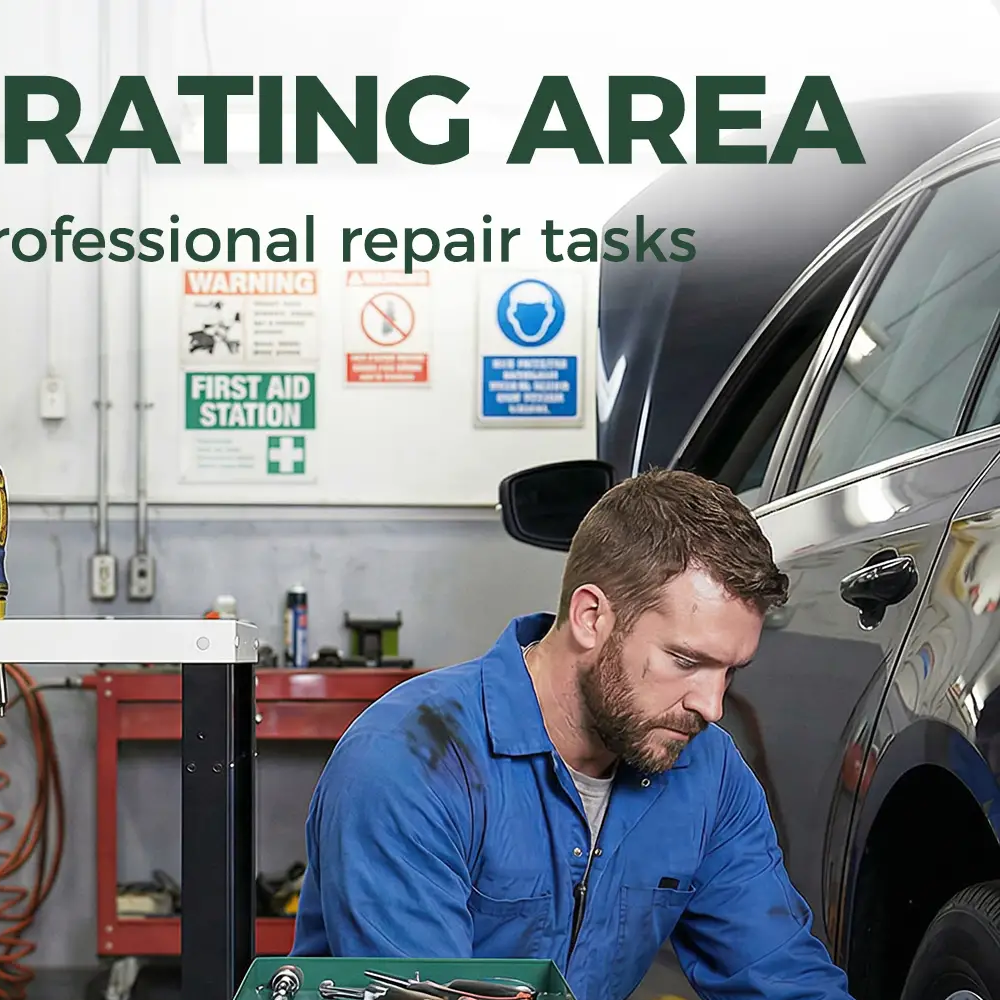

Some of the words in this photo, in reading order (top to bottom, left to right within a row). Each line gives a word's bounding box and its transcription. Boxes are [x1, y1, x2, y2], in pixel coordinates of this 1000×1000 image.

[188, 271, 315, 294] WARNING
[190, 374, 262, 400] FIRST
[266, 374, 311, 400] AID
[199, 401, 301, 428] STATION
